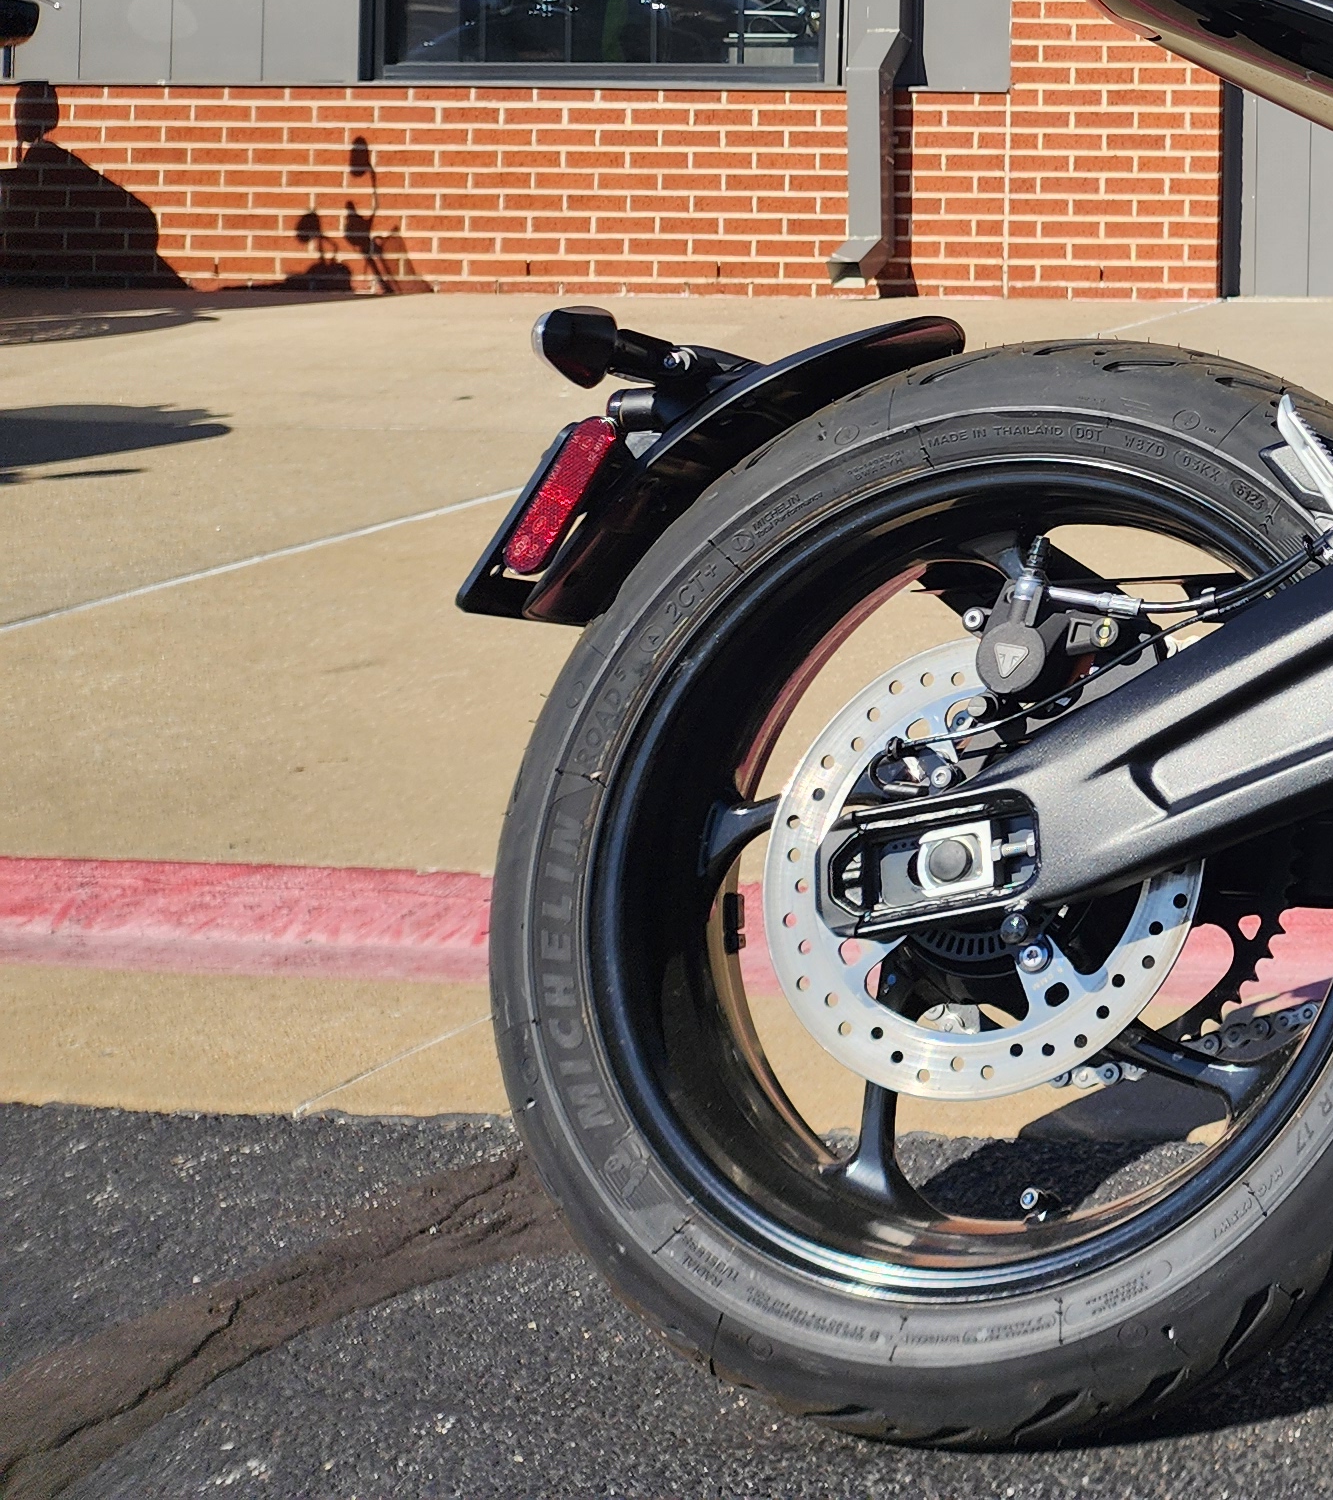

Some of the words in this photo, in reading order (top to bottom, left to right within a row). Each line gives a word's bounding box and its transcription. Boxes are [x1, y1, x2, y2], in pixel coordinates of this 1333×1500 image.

[928, 430, 968, 448] MADE
[973, 428, 986, 439] IN
[994, 424, 1064, 437] THAILAND
[1075, 427, 1104, 441] DOT
[752, 493, 801, 531] MICHELIN
[773, 490, 824, 526] Performance
[574, 691, 622, 772] ROAD
[540, 812, 614, 1132] MICHELIN
[1293, 1122, 1316, 1156] 17
